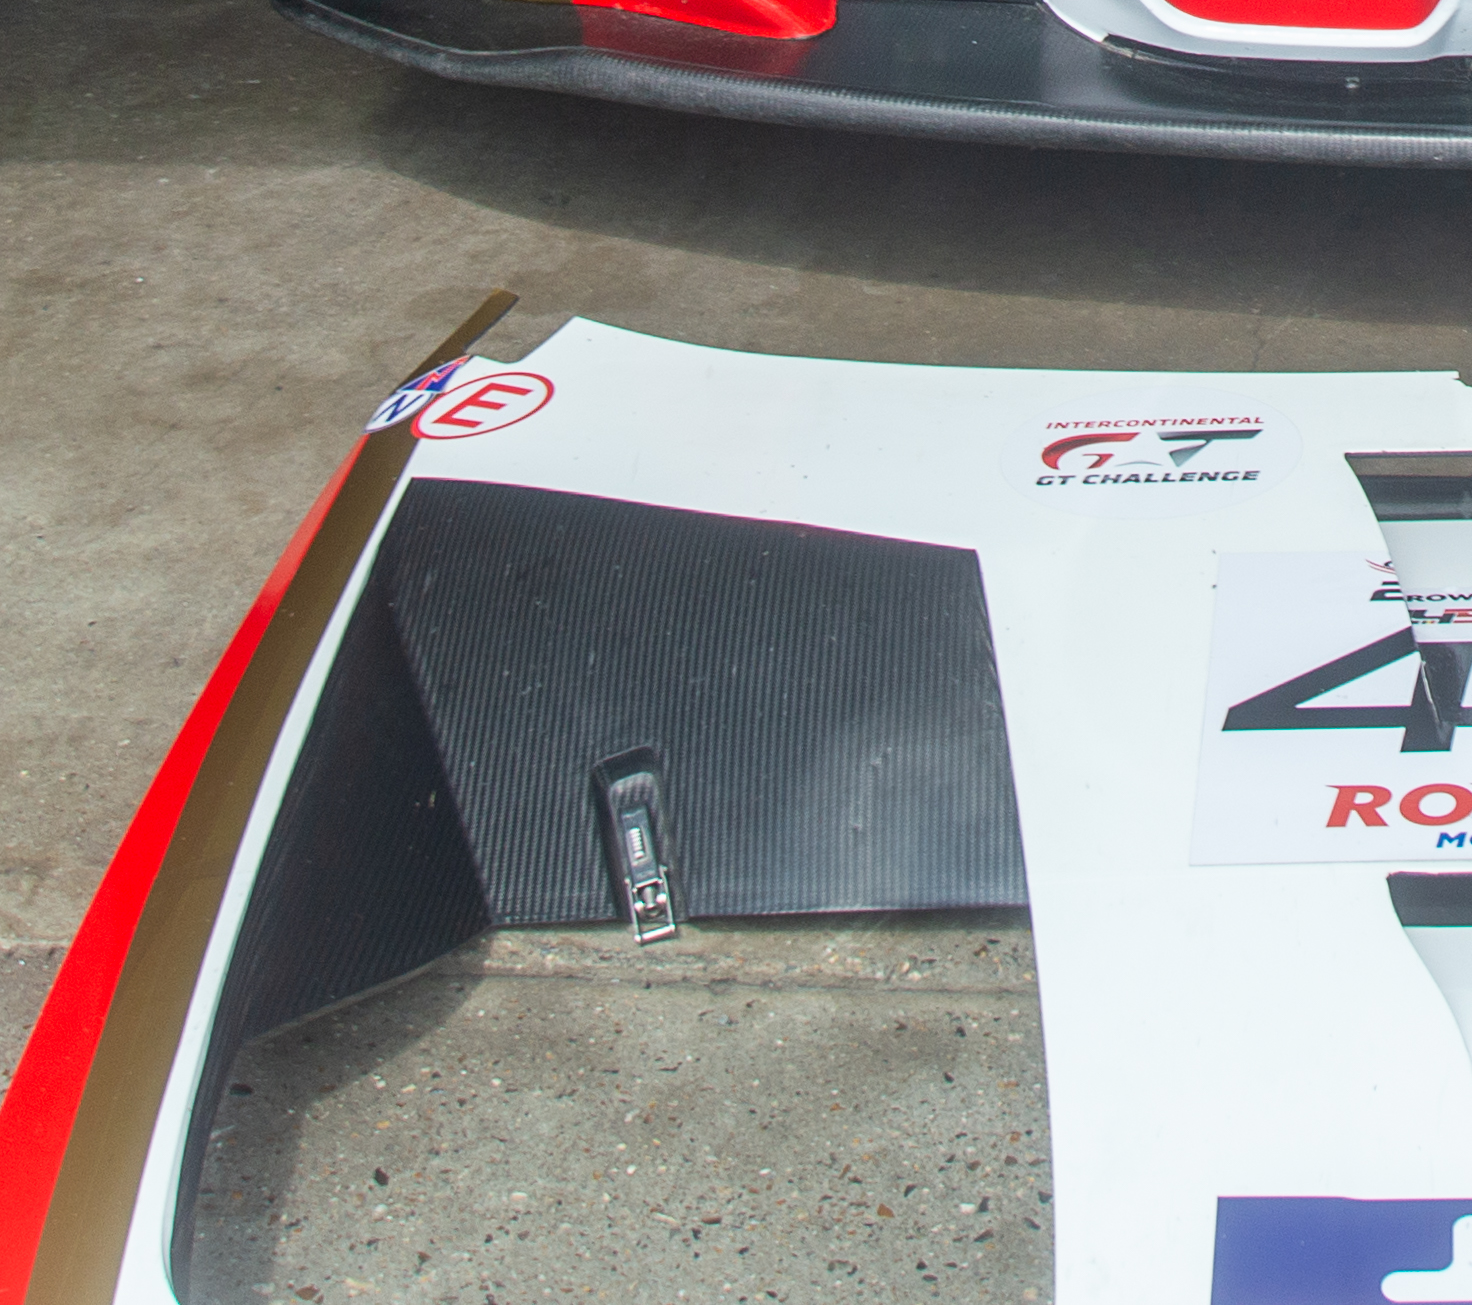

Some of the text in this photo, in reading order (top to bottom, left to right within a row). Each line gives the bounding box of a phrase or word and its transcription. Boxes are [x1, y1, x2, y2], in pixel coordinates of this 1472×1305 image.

[431, 382, 534, 429] E
[1046, 416, 1265, 430] INTERCONTINENTAL
[1035, 470, 1261, 487] GT CHALLENGE
